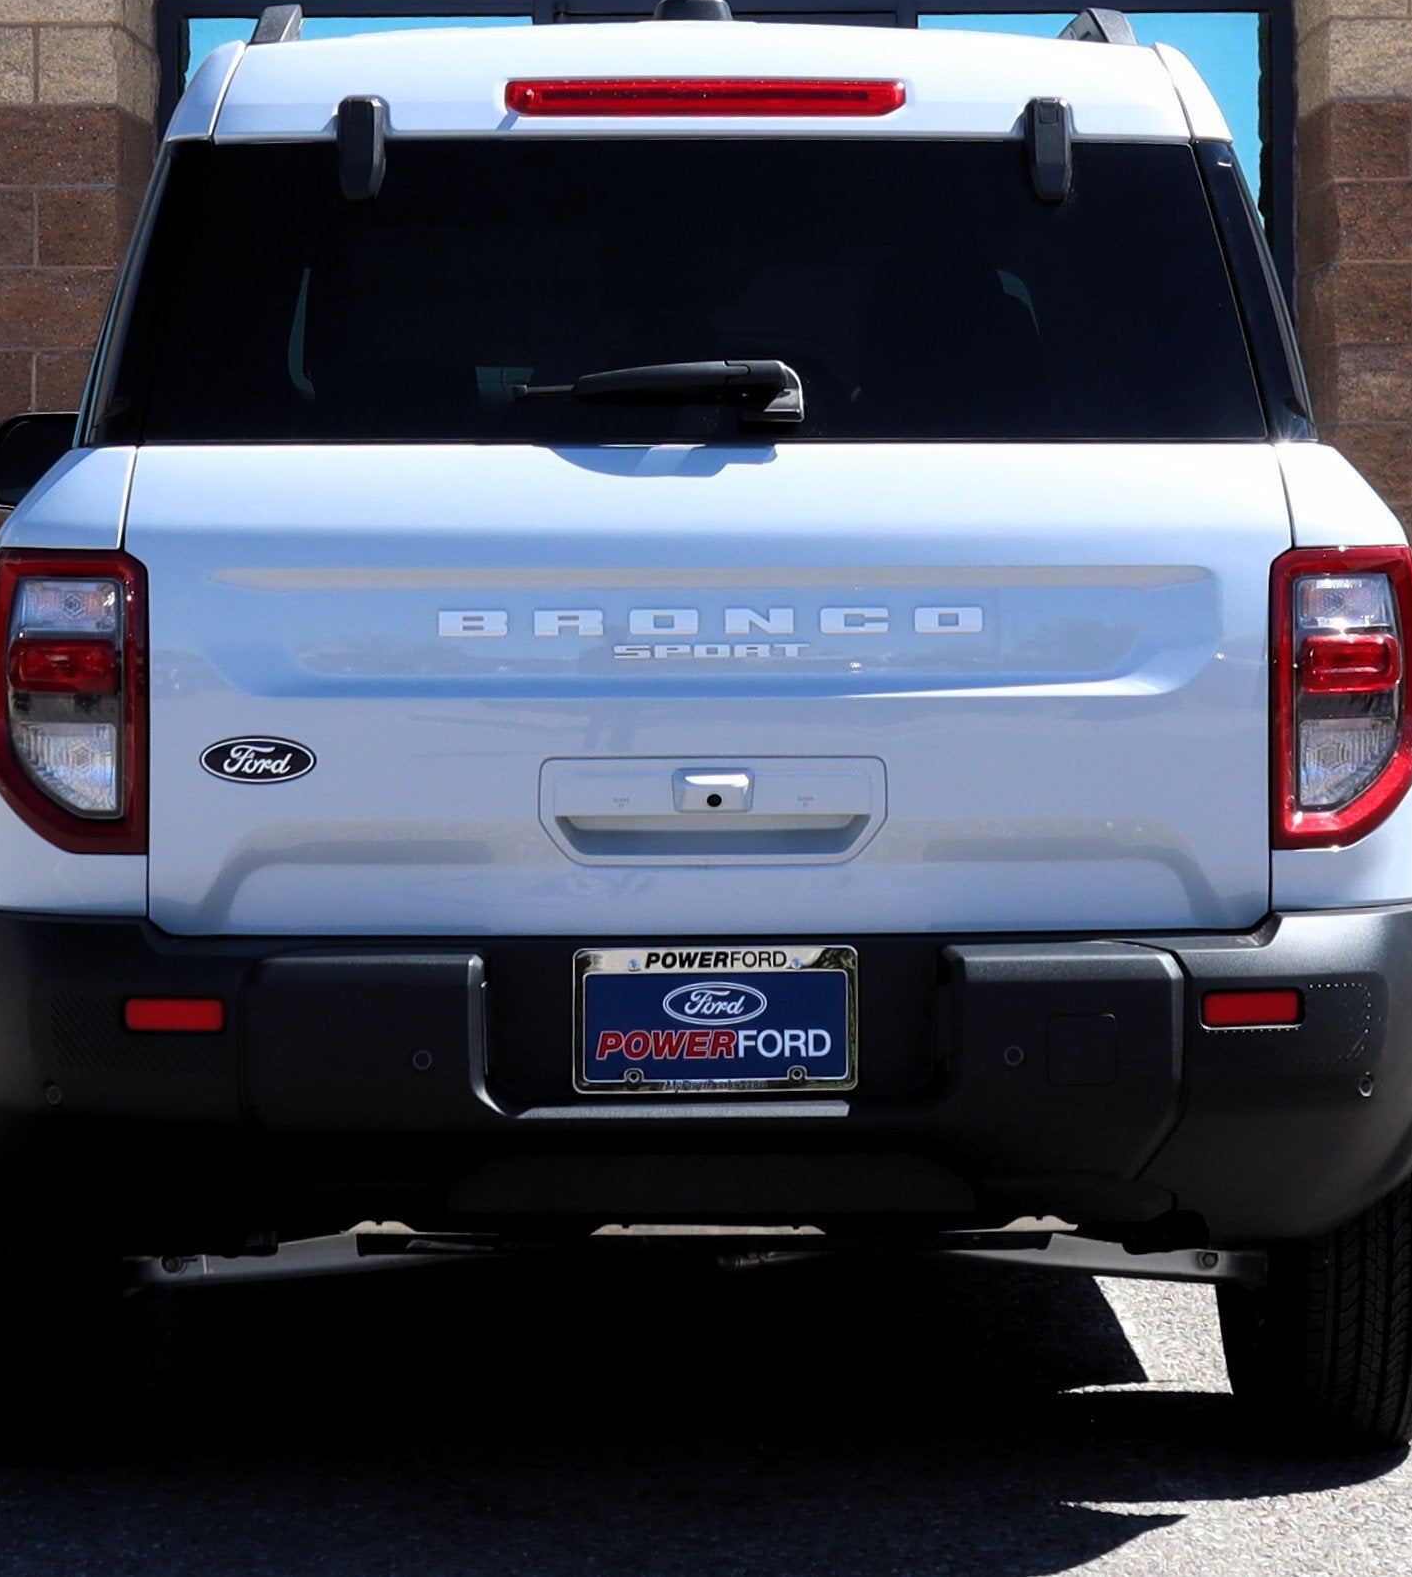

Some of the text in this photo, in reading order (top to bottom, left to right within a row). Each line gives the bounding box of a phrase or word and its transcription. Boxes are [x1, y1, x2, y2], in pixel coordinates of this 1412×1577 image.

[437, 605, 984, 638] BRONCO
[612, 642, 810, 660] SPORT
[222, 743, 293, 776] Ford
[683, 989, 745, 1016] Ford
